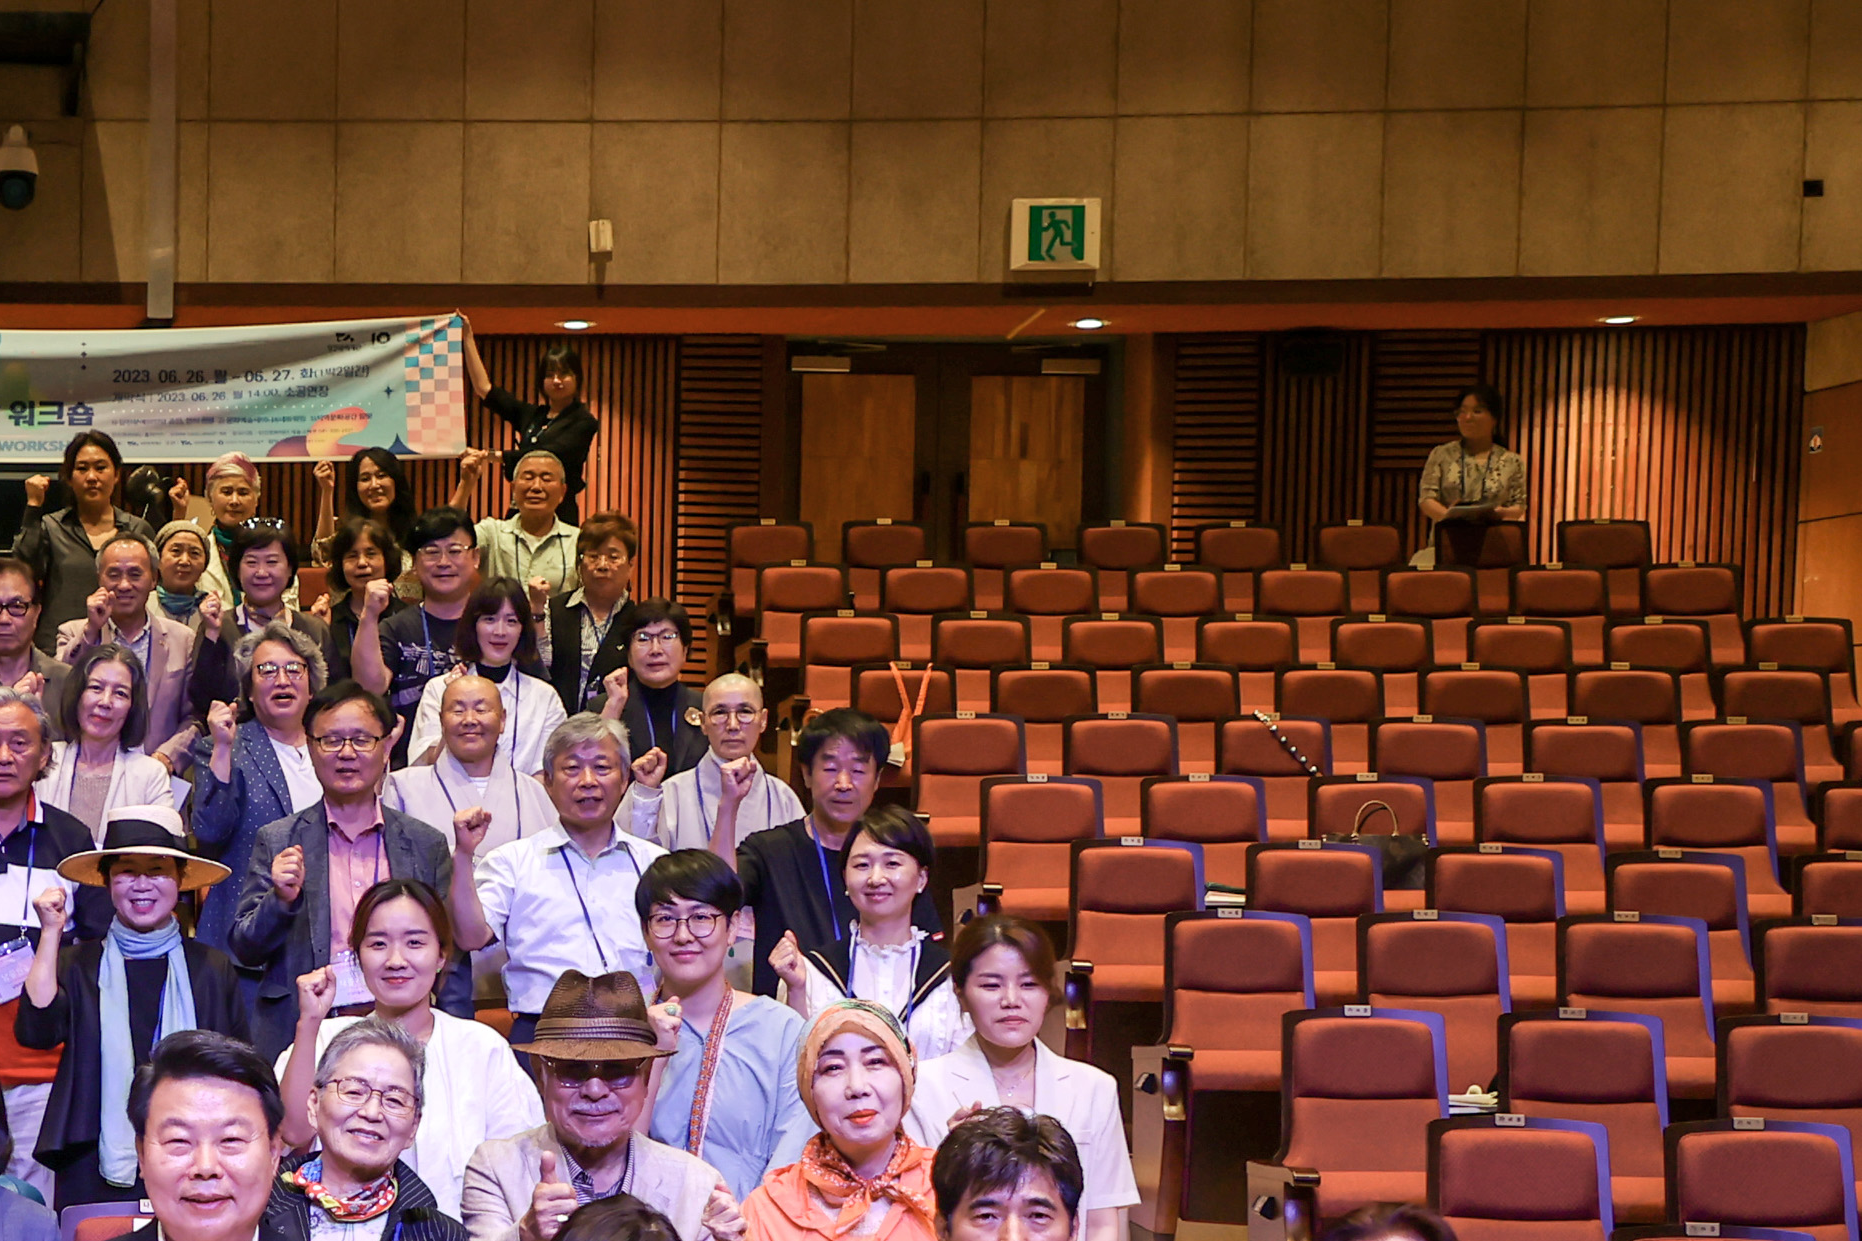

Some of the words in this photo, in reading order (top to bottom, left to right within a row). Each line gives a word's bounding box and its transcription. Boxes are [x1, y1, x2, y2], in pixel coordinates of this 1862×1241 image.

[158, 369, 181, 384] 06.
[272, 368, 295, 382] 27.
[7, 401, 95, 427] 워크숍
